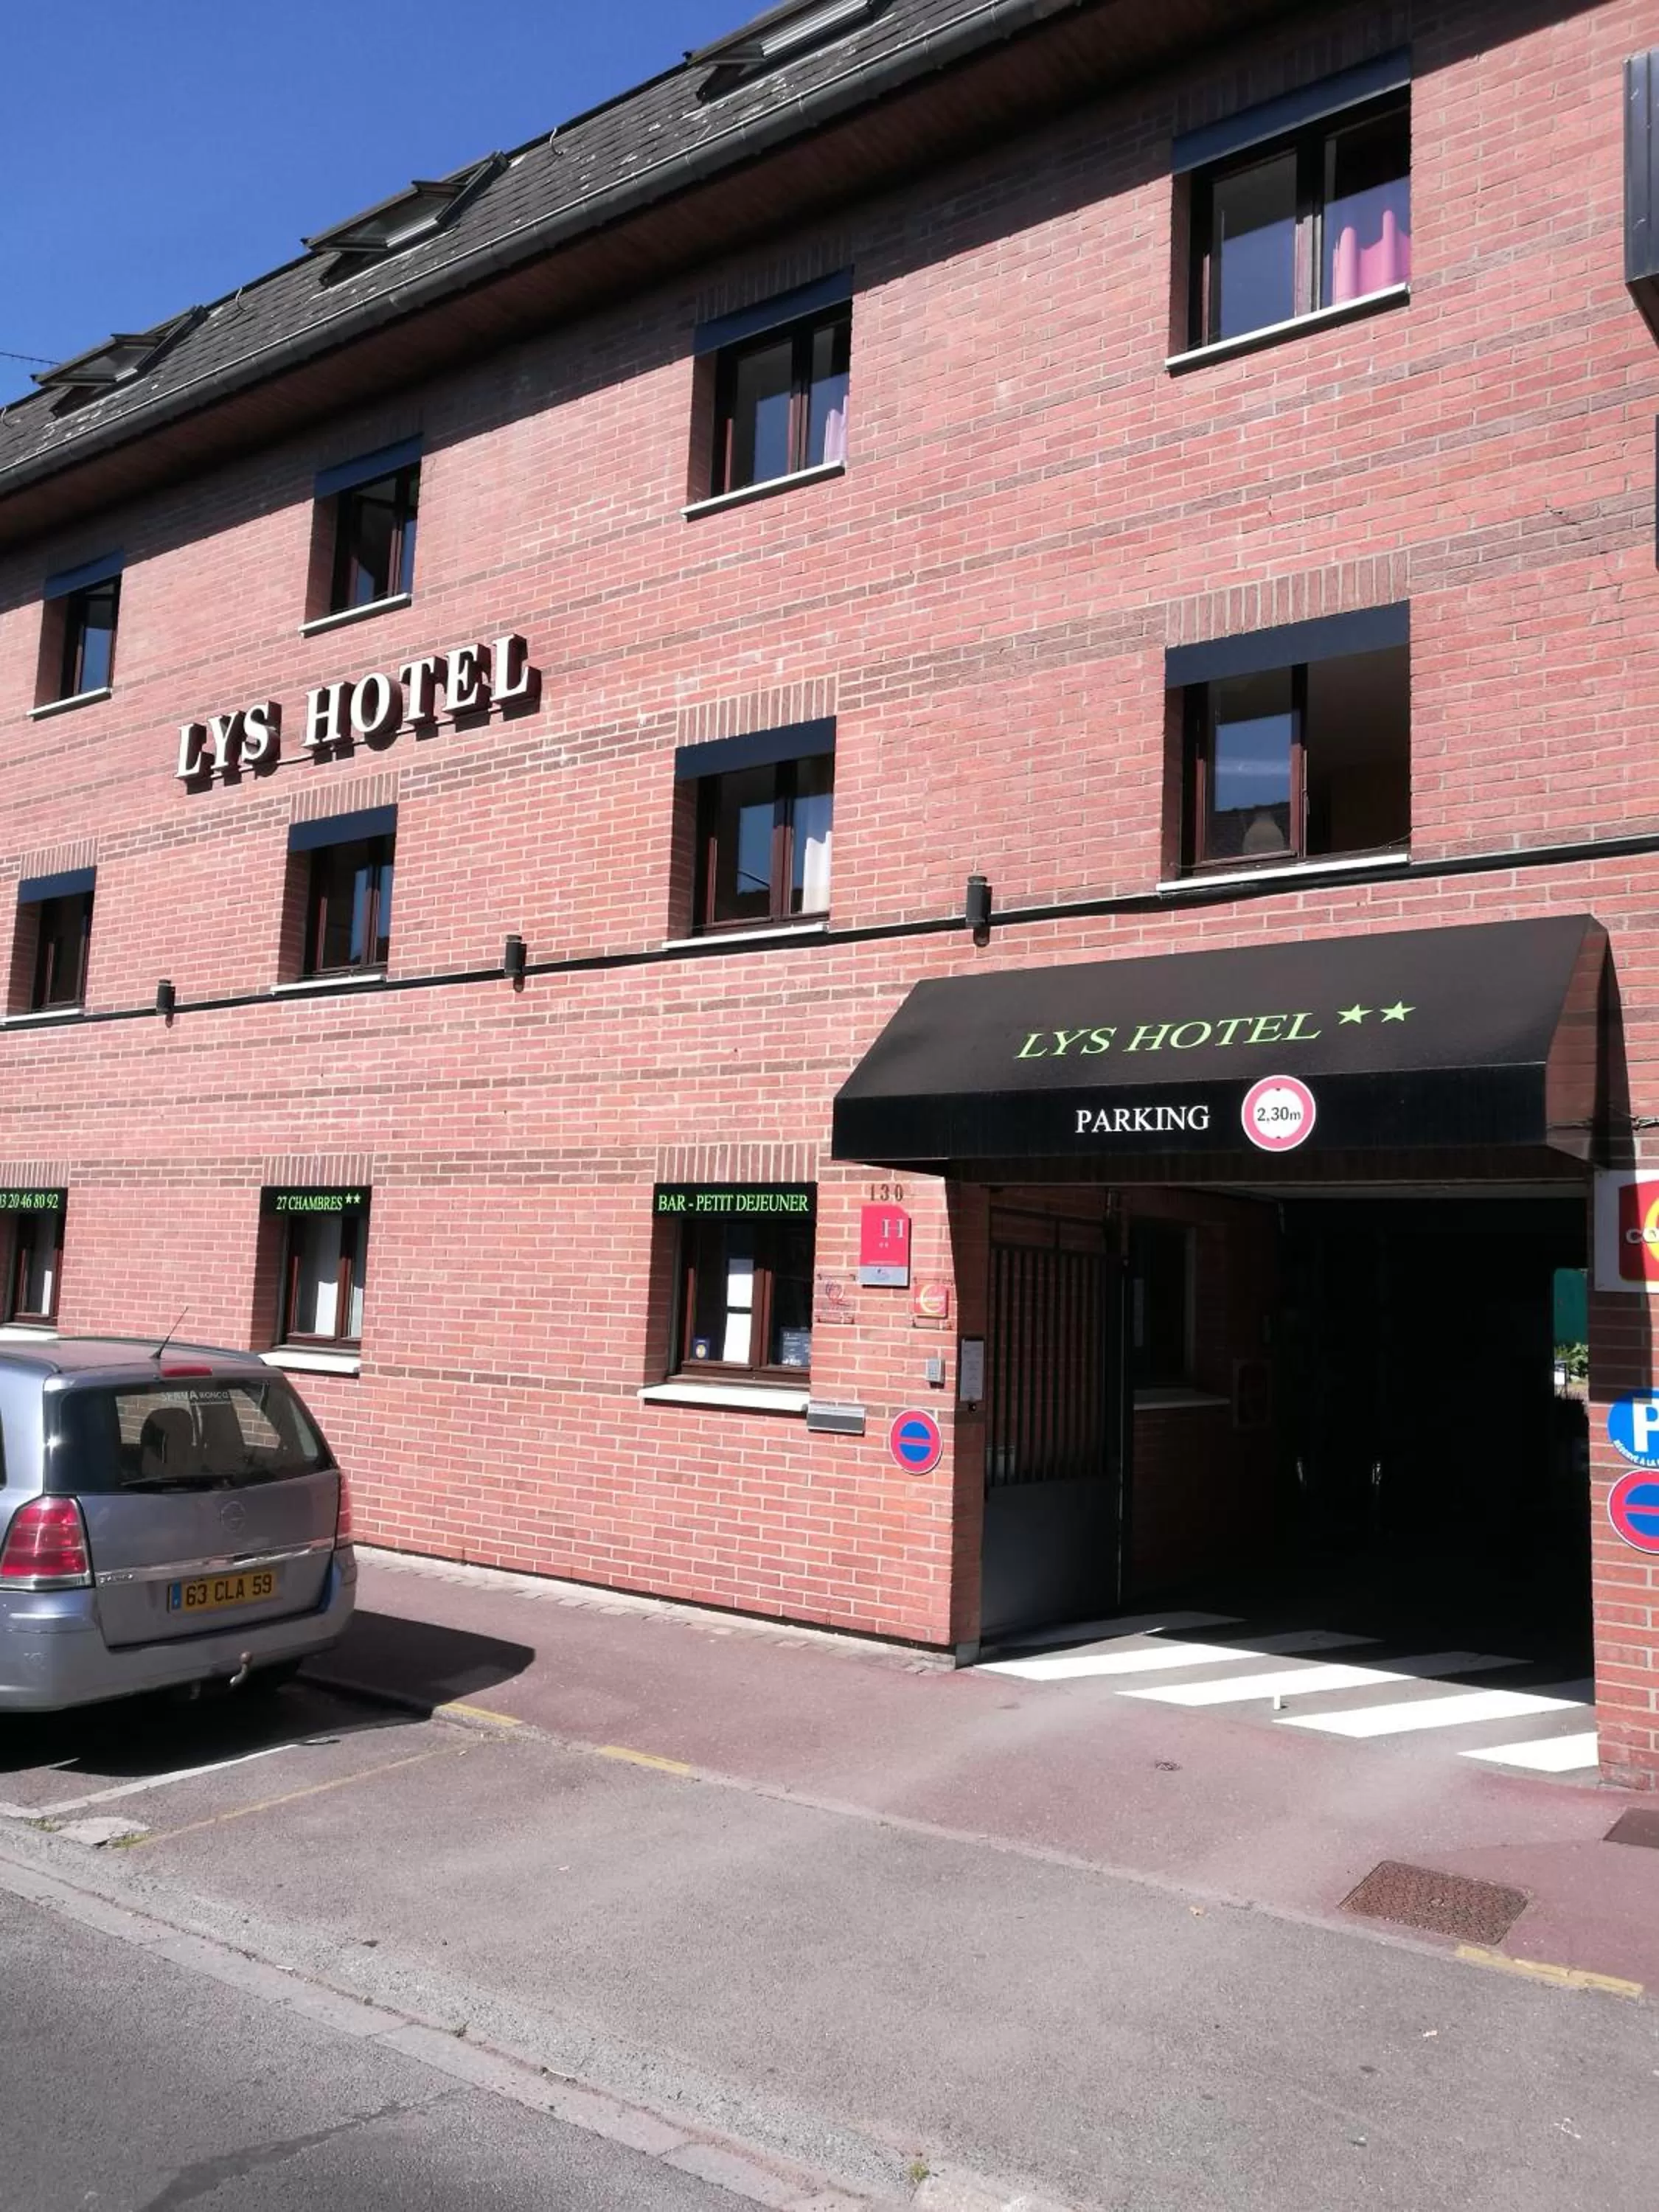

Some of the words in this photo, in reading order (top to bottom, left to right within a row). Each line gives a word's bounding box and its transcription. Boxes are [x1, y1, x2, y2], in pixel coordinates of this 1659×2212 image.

[175, 700, 280, 780] LYS
[302, 634, 540, 748] HOTEL
[1014, 1026, 1117, 1060] LYS
[1122, 1011, 1324, 1053] HOTEL
[1074, 1105, 1211, 1134] PARKING
[276, 1195, 287, 1211] 27
[288, 1194, 344, 1211] CHAMBRES
[658, 1194, 686, 1211] BAR
[695, 1194, 734, 1212] PETIT
[736, 1194, 809, 1212] DEJEUNER
[869, 1183, 904, 1202] 130
[1632, 1397, 1659, 1453] P
[186, 1584, 208, 1607] 63
[214, 1578, 246, 1602] CLA
[251, 1573, 273, 1596] 59
